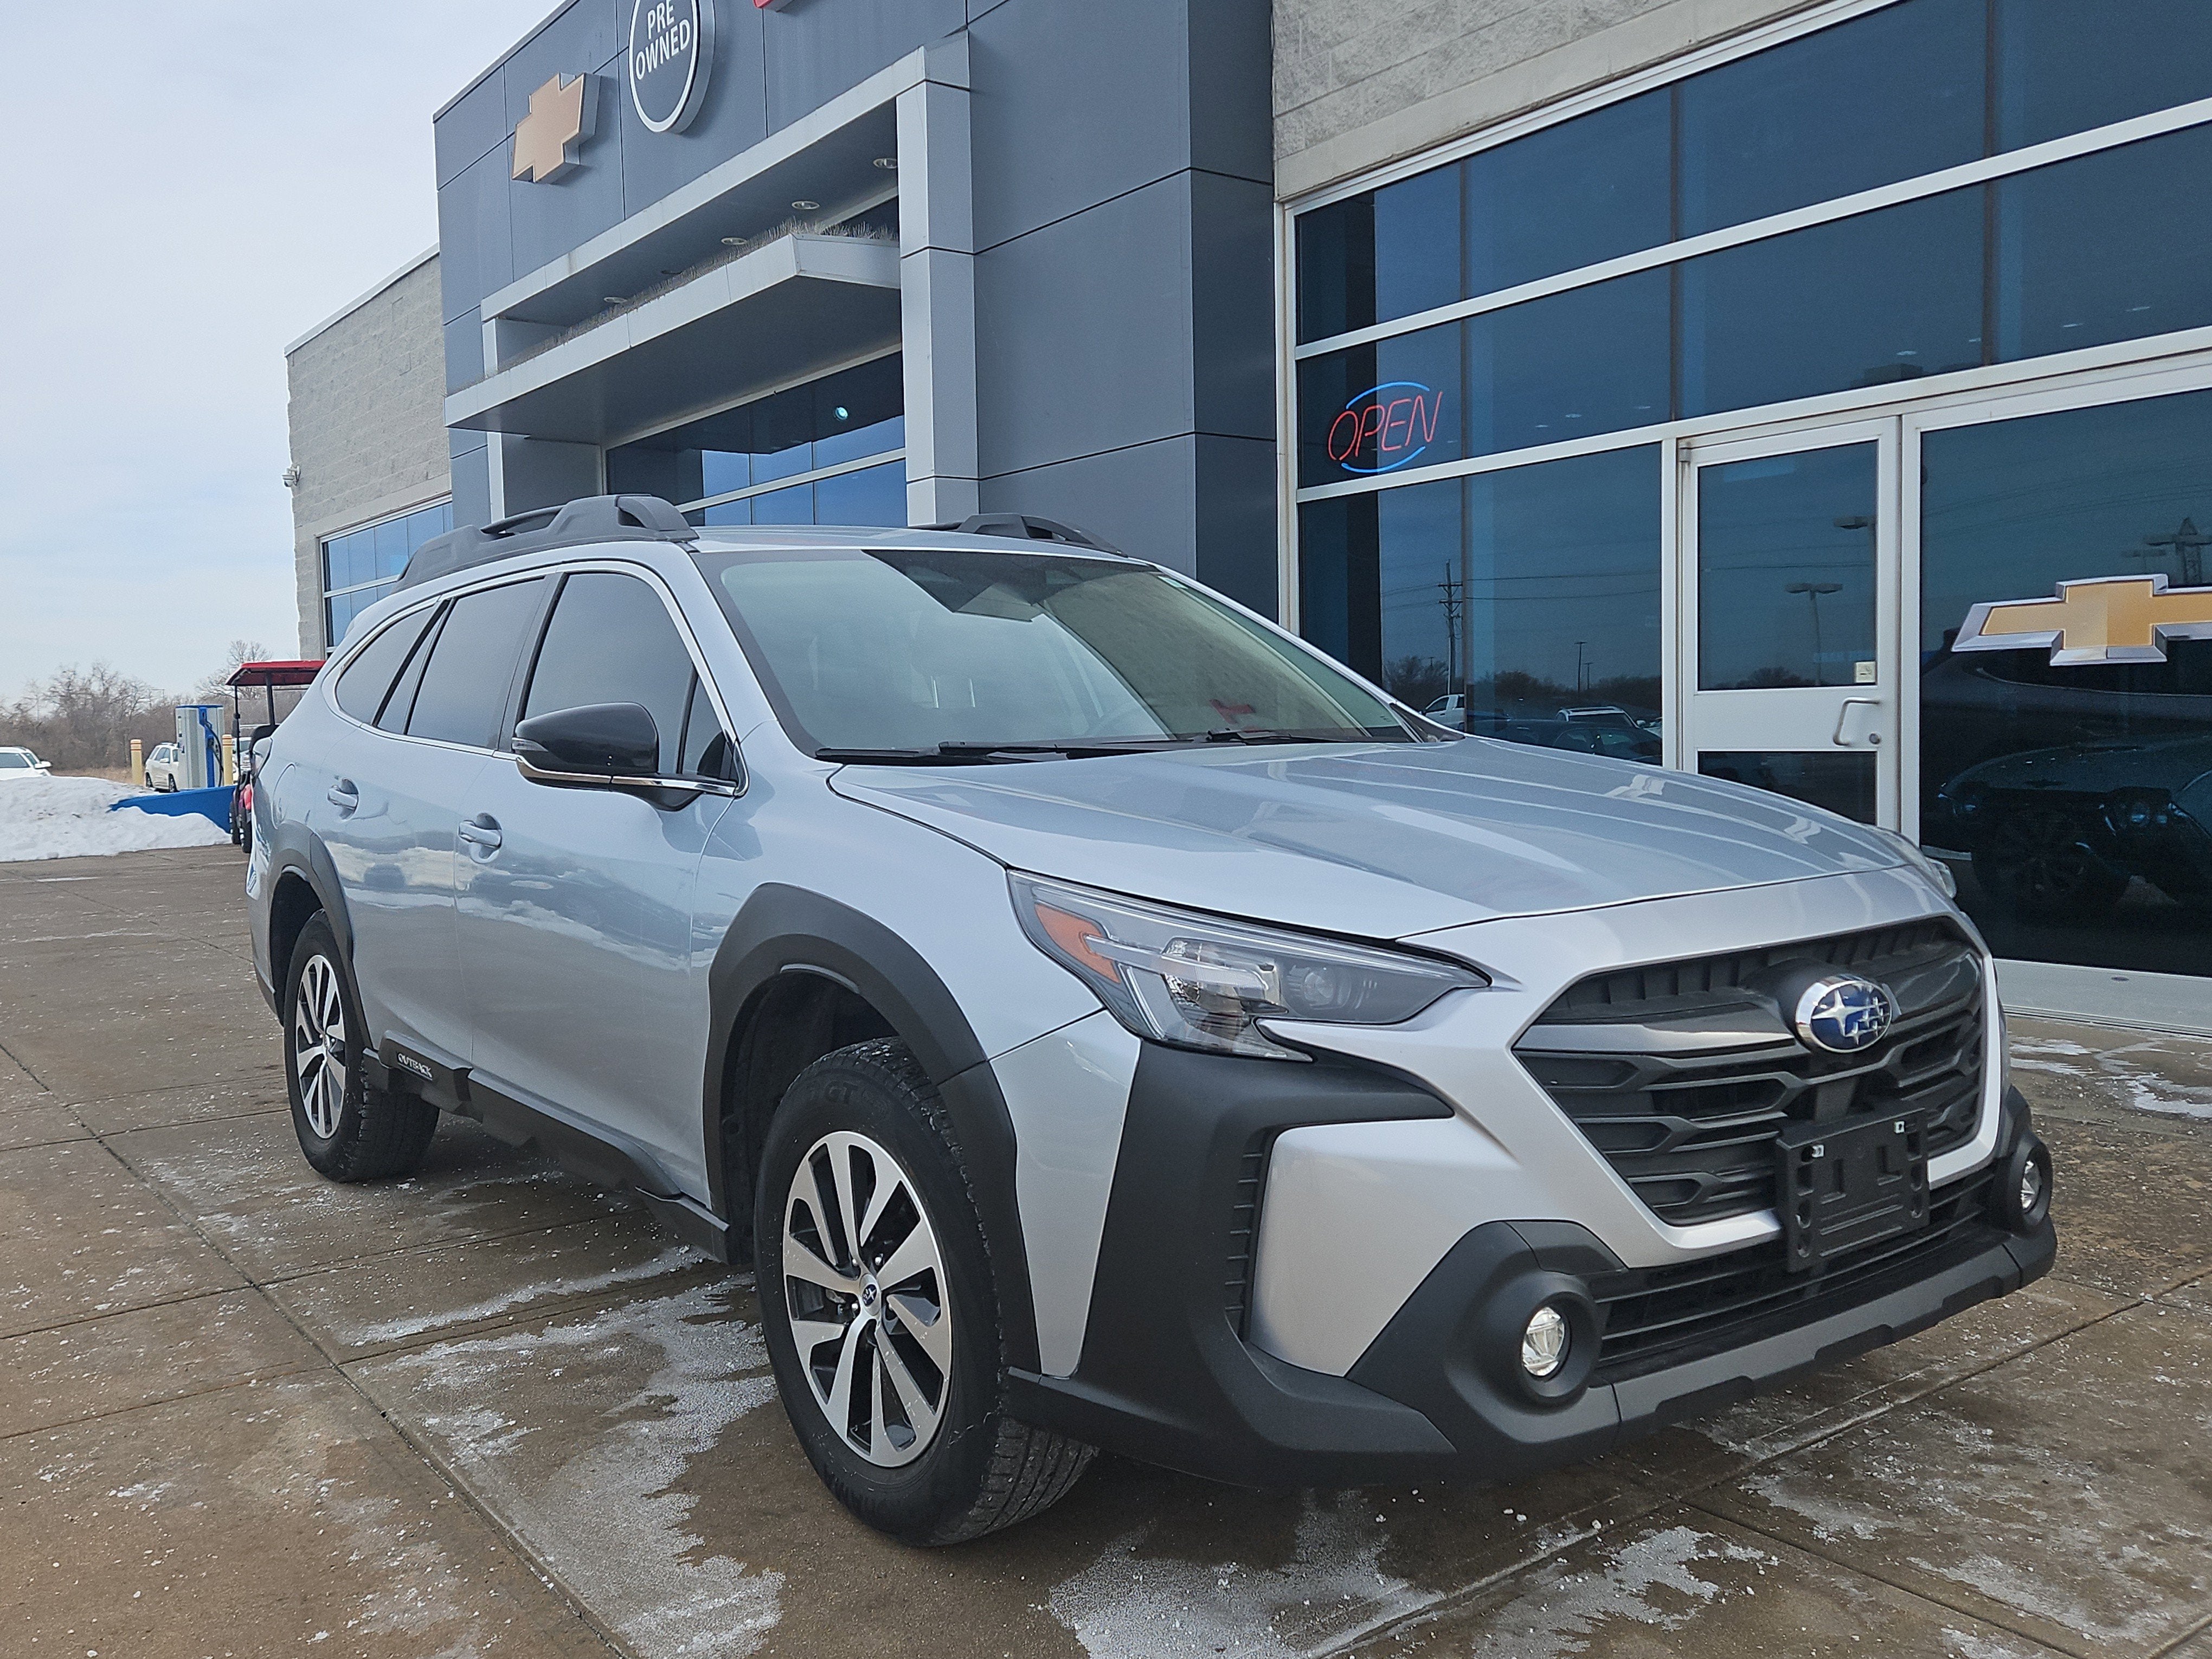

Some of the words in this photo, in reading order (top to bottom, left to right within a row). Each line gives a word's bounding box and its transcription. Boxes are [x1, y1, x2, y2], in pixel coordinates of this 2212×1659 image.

[647, 0, 674, 40] PRE
[636, 19, 690, 80] OWNED
[1328, 391, 1443, 461] OPEN
[398, 1053, 433, 1078] OUTBACK
